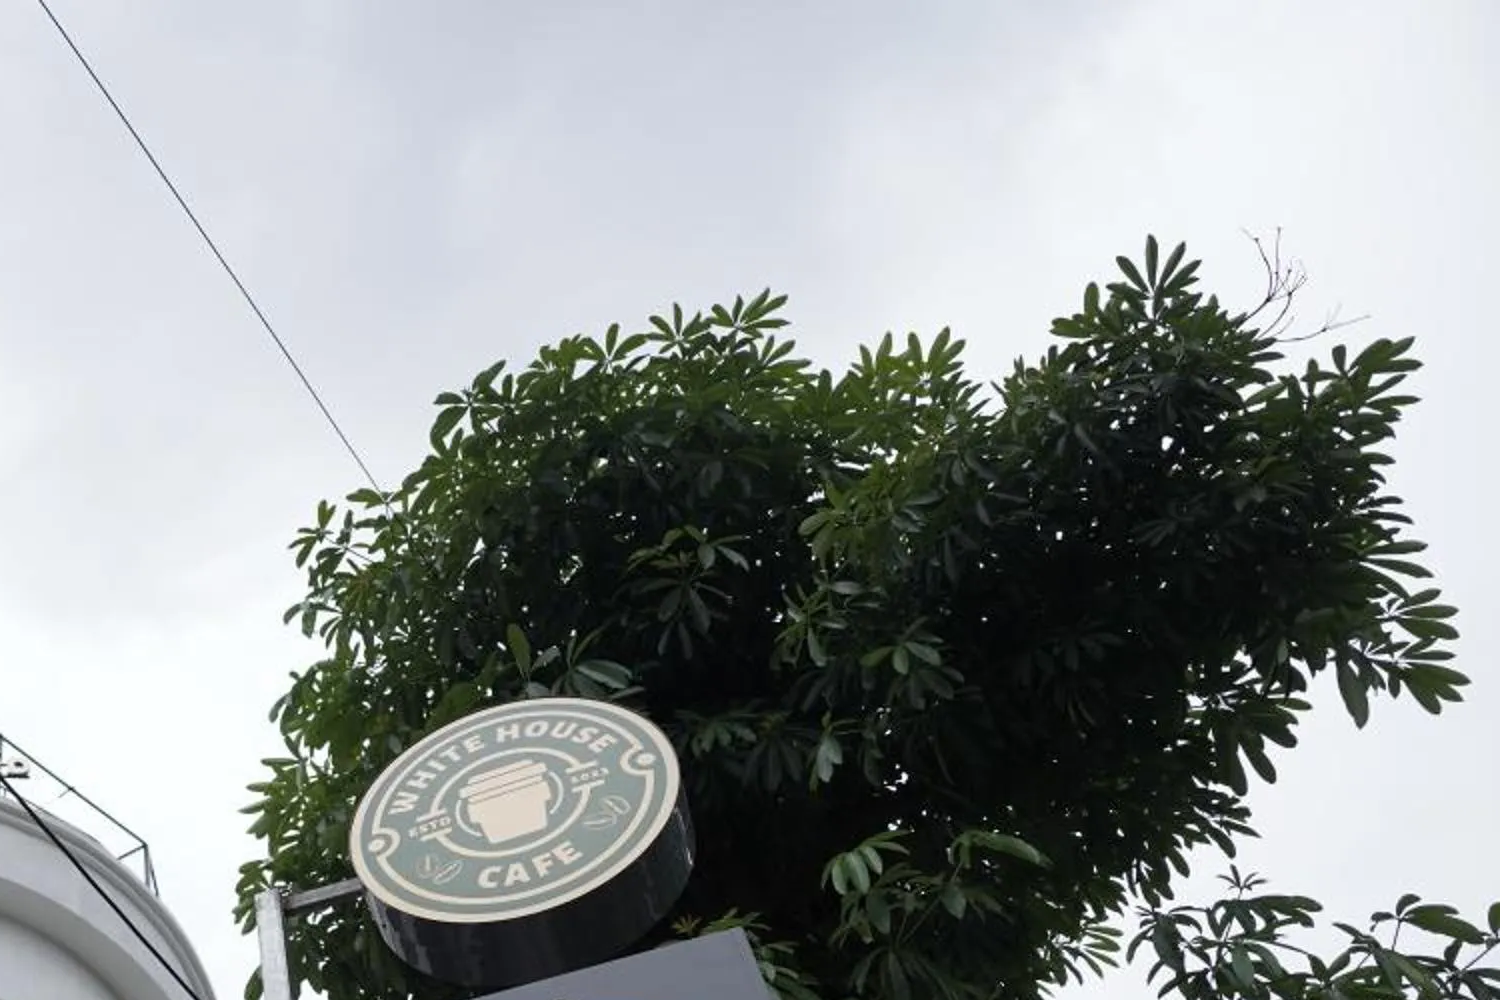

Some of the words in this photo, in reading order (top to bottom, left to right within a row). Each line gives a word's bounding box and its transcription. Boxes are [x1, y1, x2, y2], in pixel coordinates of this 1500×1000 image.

[388, 735, 485, 816] WHITE
[495, 720, 618, 753] HOUSE
[477, 840, 583, 889] CAFE
